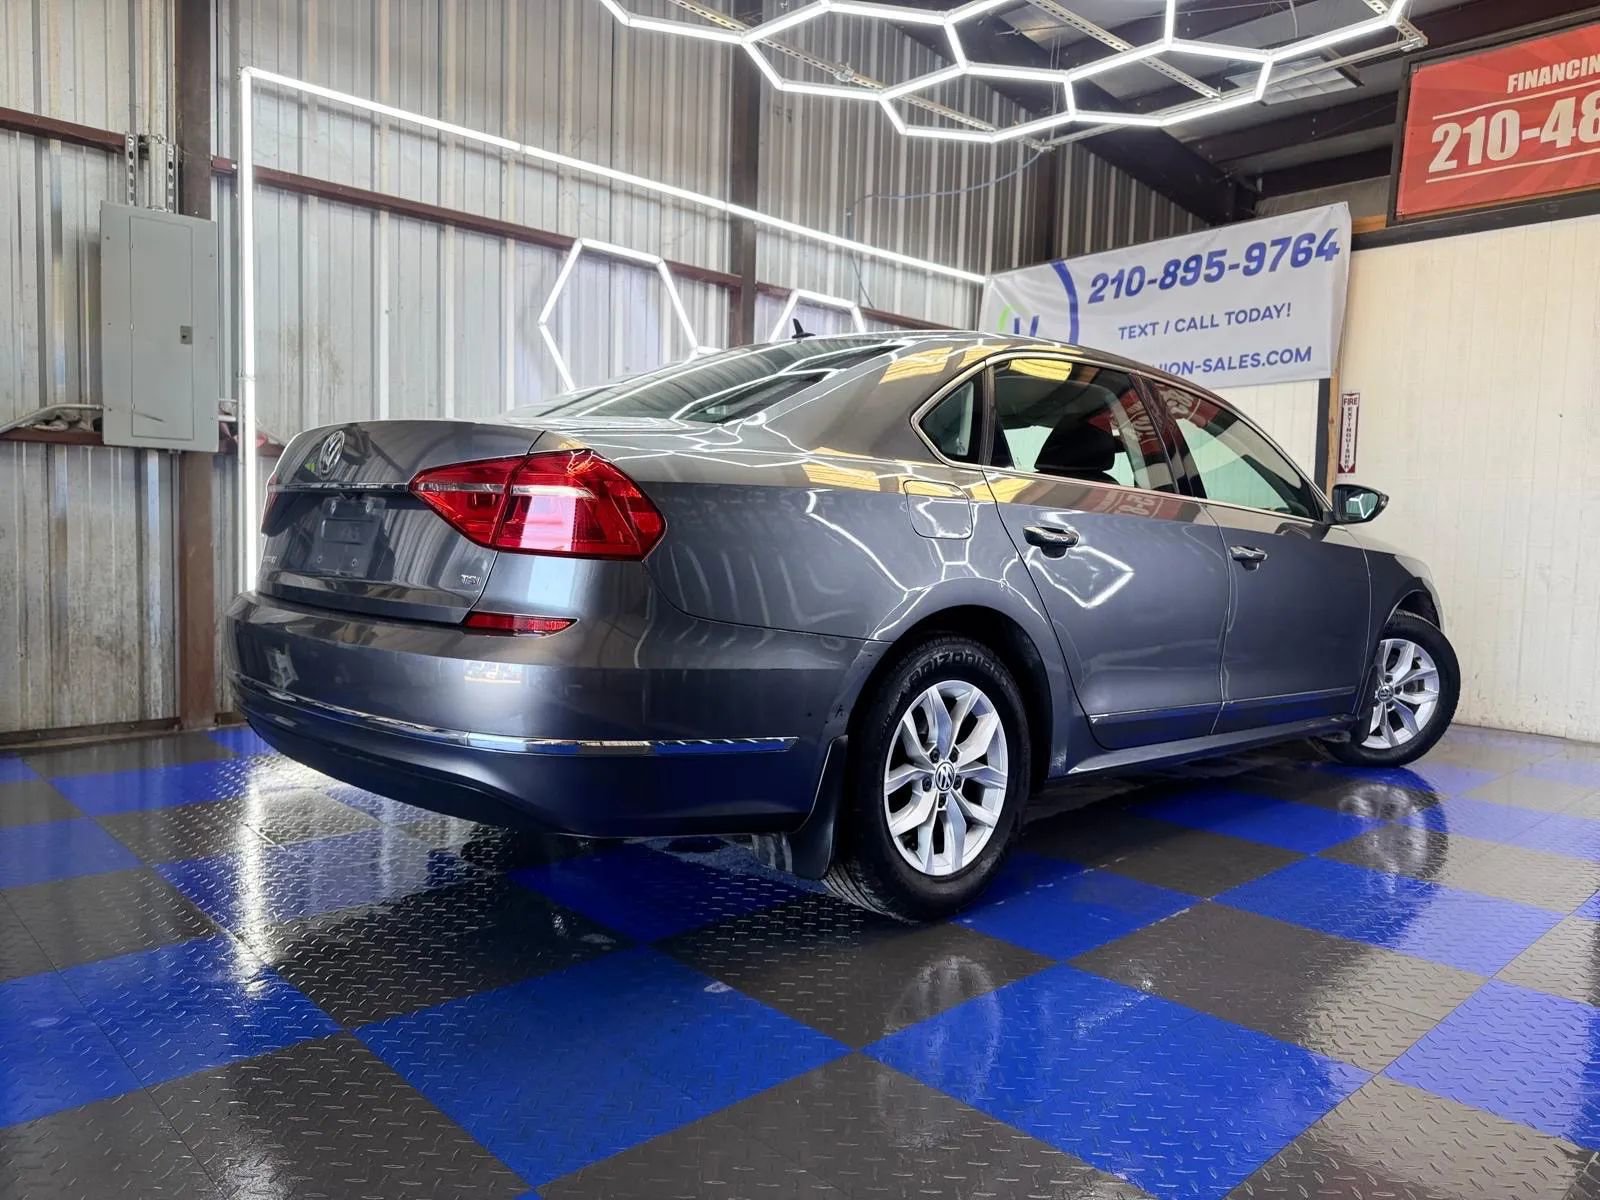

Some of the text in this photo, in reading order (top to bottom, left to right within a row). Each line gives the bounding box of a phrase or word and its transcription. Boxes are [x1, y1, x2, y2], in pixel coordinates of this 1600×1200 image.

[1507, 53, 1600, 94] FINANCIN
[1428, 90, 1600, 173] 210-48
[1087, 228, 1340, 304] 210-895-9764
[1118, 302, 1291, 340] TEXT / CALL TODAY!
[1343, 397, 1358, 405] FIRE
[1344, 407, 1352, 469] EXTINGUISHER
